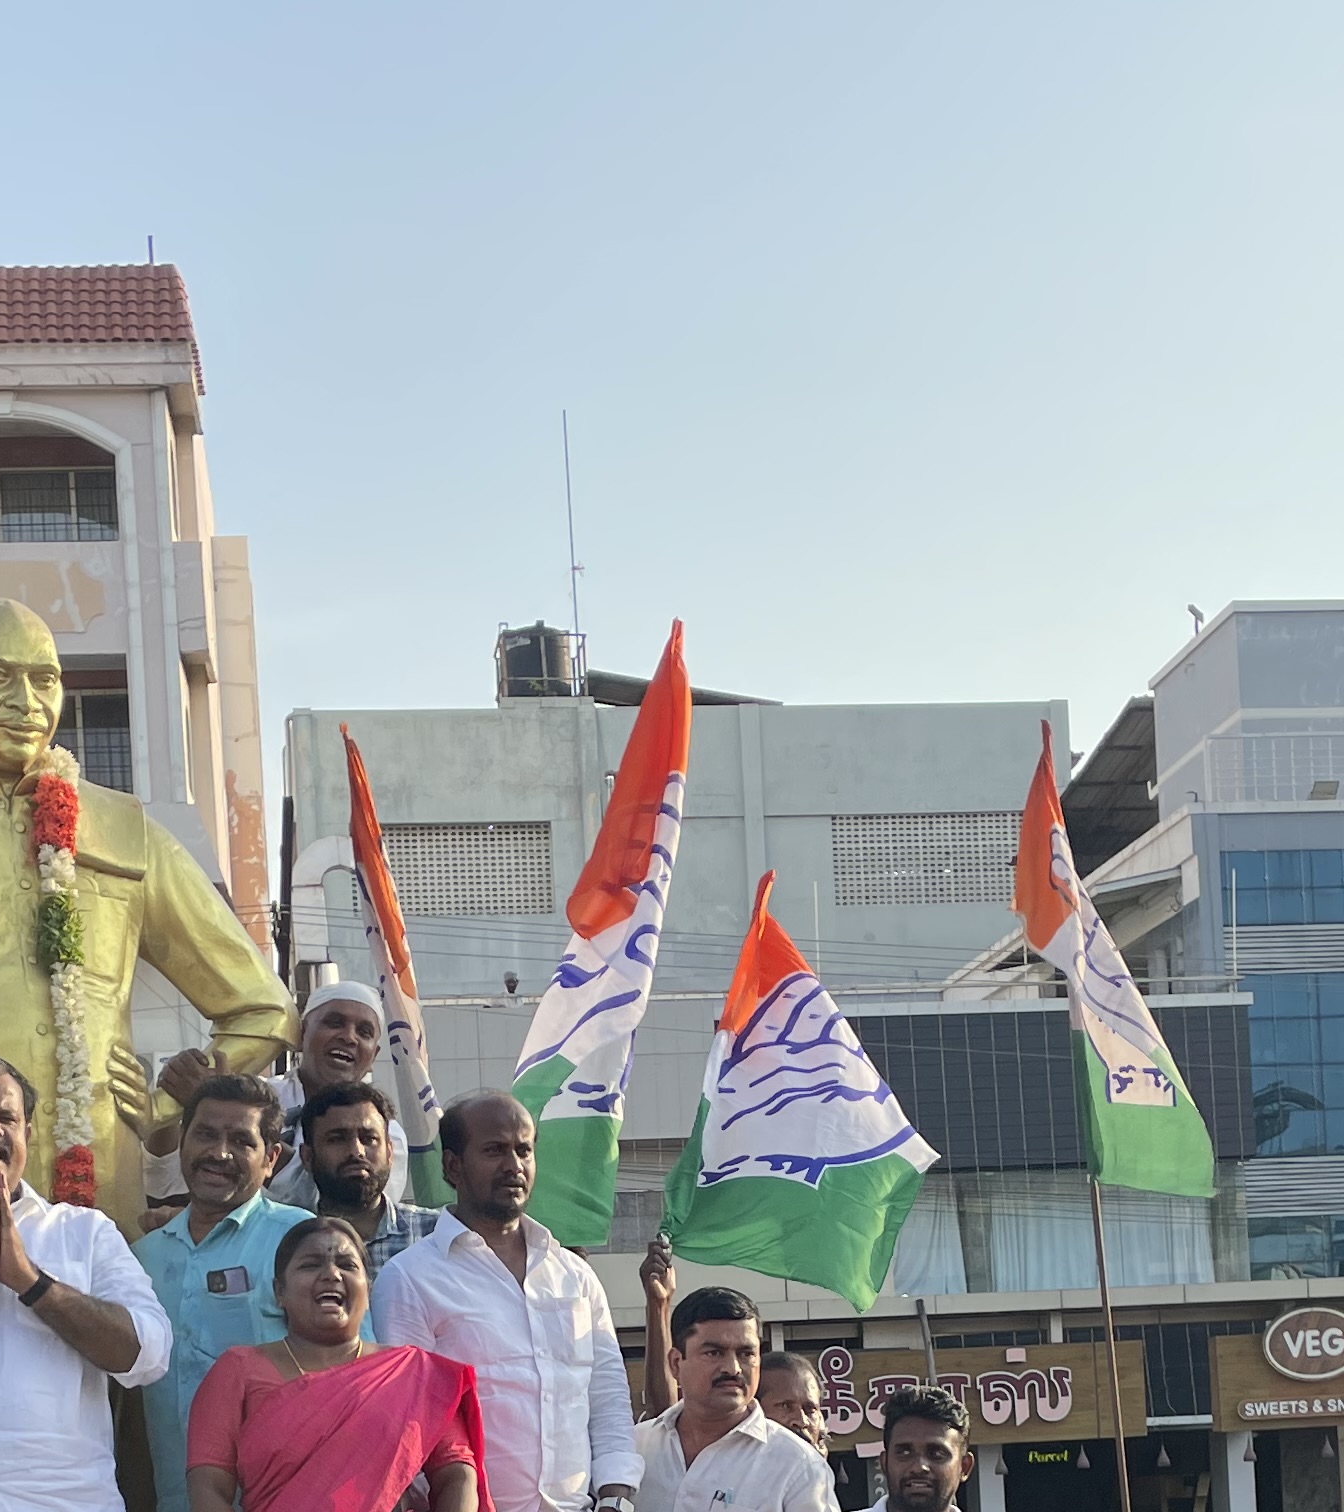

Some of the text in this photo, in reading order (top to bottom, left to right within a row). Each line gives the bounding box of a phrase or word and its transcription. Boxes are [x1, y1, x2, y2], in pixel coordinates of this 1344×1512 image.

[1244, 1399, 1308, 1417] SWEETS
[1312, 1398, 1323, 1413] &
[1028, 1449, 1068, 1463] Parcel
